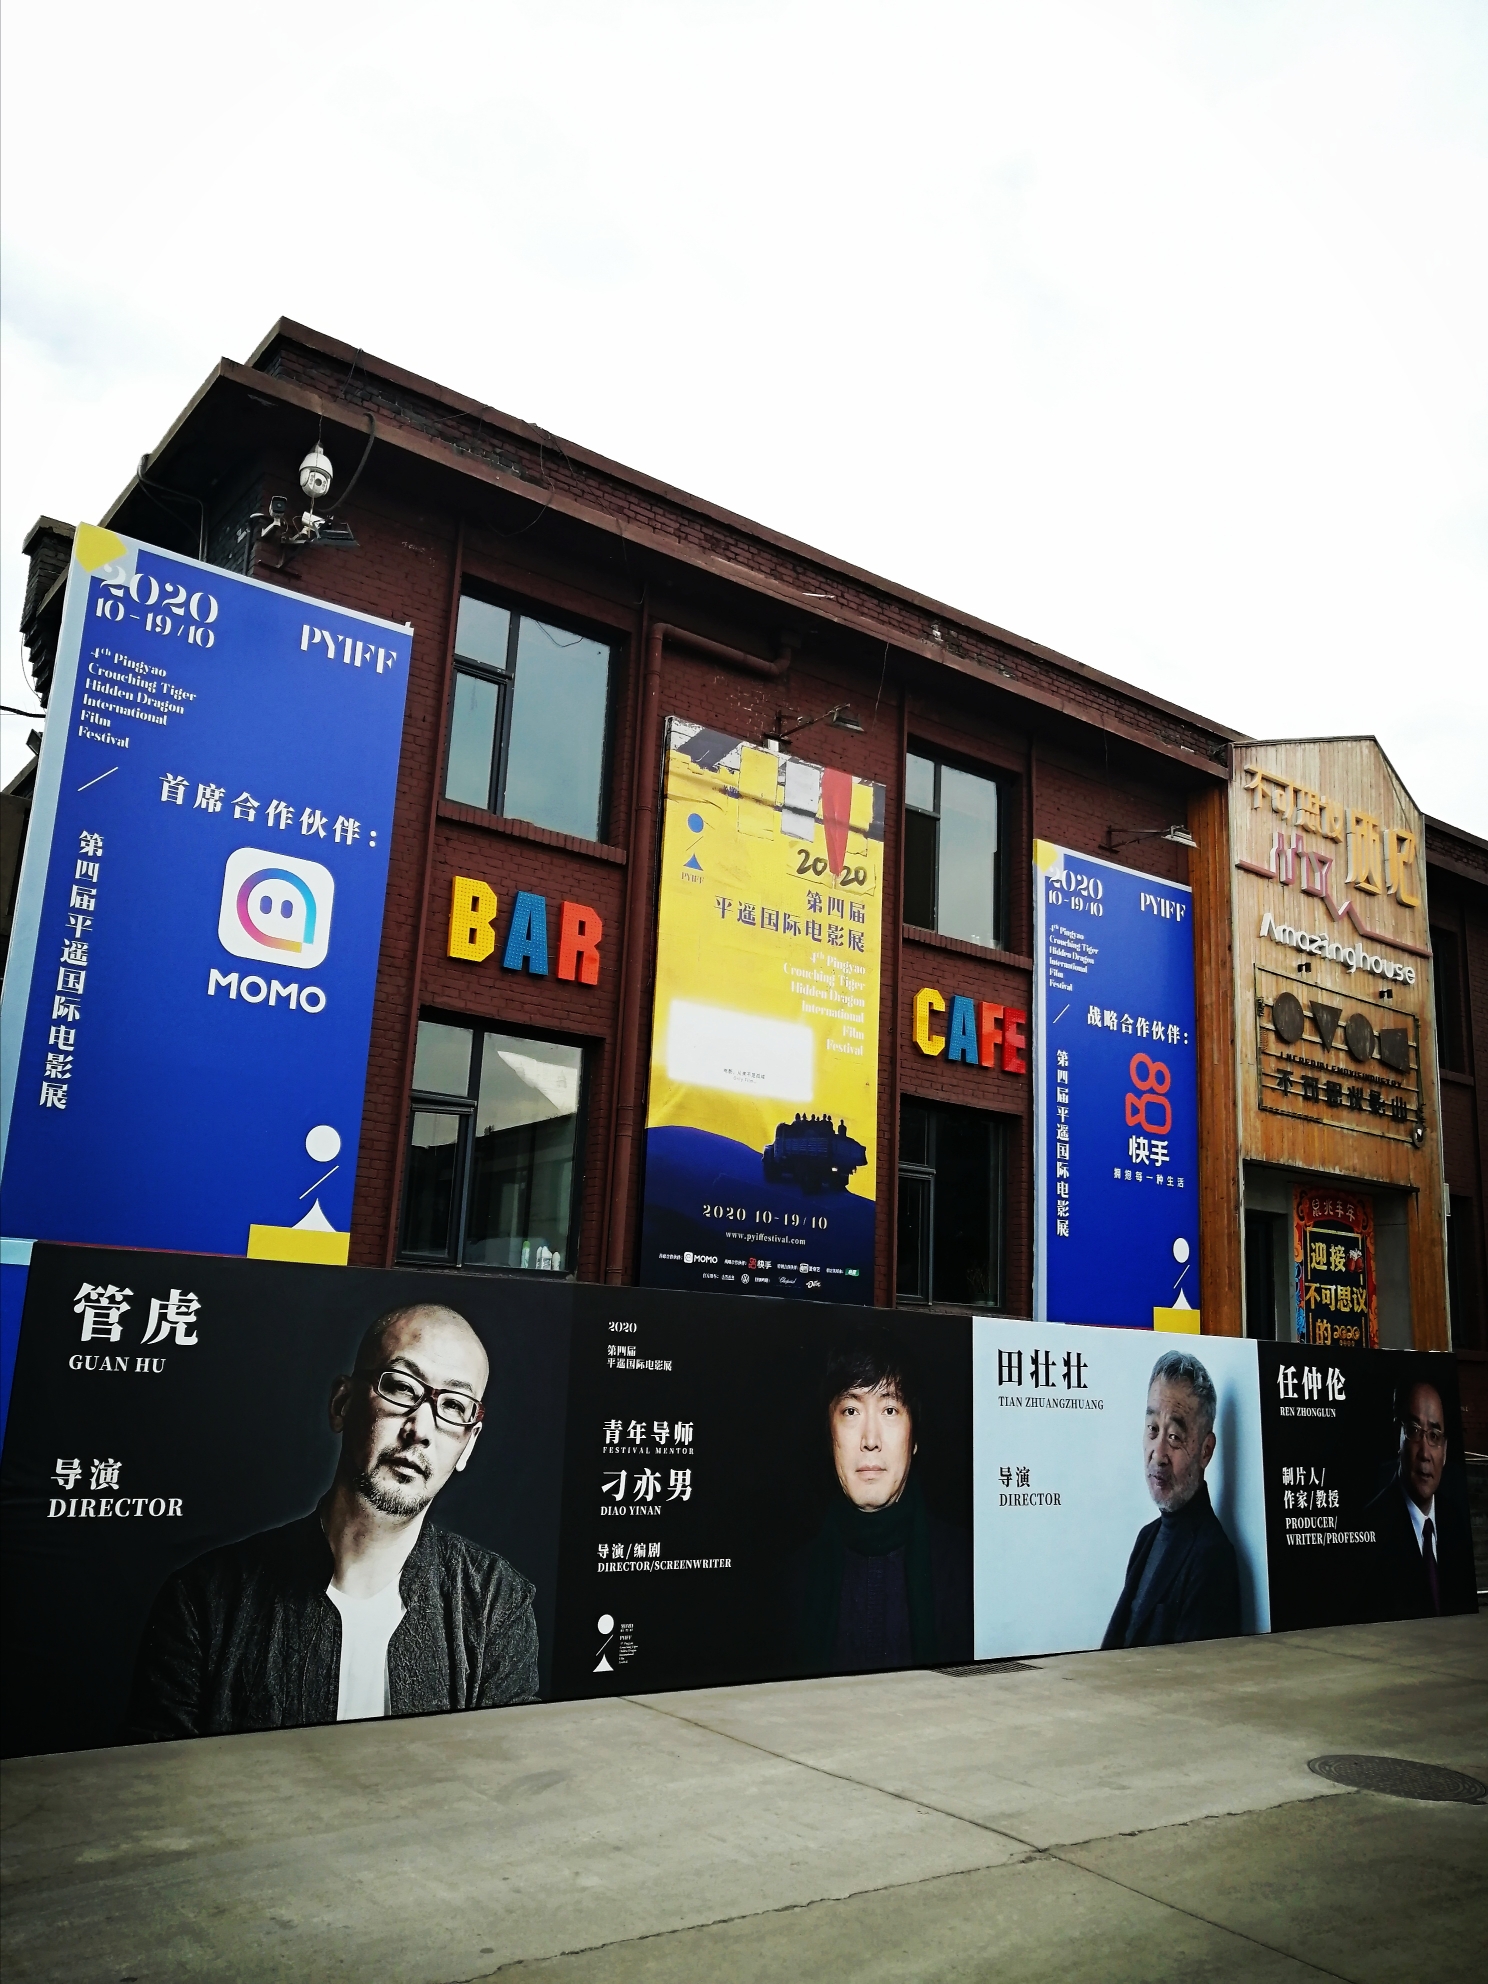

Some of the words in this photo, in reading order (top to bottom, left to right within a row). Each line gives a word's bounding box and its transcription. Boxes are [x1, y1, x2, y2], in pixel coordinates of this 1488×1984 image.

[100, 564, 218, 624] 2020
[300, 624, 397, 674] PYIFF
[113, 652, 167, 677] Pingyao
[88, 662, 157, 693] Crouching
[161, 682, 197, 702] Tiger
[85, 678, 134, 702] Hidden
[137, 693, 185, 715] Dragon
[80, 709, 112, 728] Film
[82, 694, 168, 727] International
[78, 725, 130, 749] Festival
[681, 871, 705, 885] PYIFF
[1048, 866, 1103, 900] 2020
[806, 889, 865, 924] 第四届
[1140, 892, 1186, 922] PYIFF
[447, 875, 603, 986] BAR
[714, 895, 865, 953] 平遥国际电影展
[1059, 927, 1085, 941] Pingyao
[1049, 935, 1081, 952] Crouching
[1081, 943, 1100, 955] Tiger
[1049, 946, 1072, 959] Hidden
[1073, 951, 1095, 965] Dragon
[39, 829, 104, 1110] 第四届平遥国际电影展
[827, 955, 866, 975] Pingyao
[1049, 957, 1088, 974] International
[1049, 968, 1064, 979] Film
[783, 964, 836, 985] Crouching
[839, 976, 866, 992] Tiger
[1049, 979, 1073, 992] Festival
[207, 968, 326, 1014] MOMO
[790, 981, 827, 1000] Hidden
[829, 989, 865, 1008] Dragon
[801, 1001, 865, 1024] International
[842, 1026, 865, 1041] Film
[912, 987, 1027, 1074] CAFE
[826, 1039, 864, 1057] Festival
[1056, 1049, 1070, 1238] 第四届平遥国际电影展
[1128, 1135, 1170, 1167] 快手
[1113, 1167, 1185, 1188] 拥抱每一种生活
[702, 1204, 747, 1221] 2020
[725, 1231, 806, 1246] www.pyiffestival.com
[694, 1254, 718, 1264] MOMO
[1310, 1242, 1346, 1273] 迎接
[1305, 1282, 1368, 1314] 不可思议
[73, 1282, 201, 1345] 管虎
[608, 1321, 638, 1333] 2020
[606, 1344, 636, 1357] 第四届
[68, 1354, 130, 1372] GUAN
[134, 1357, 167, 1374] HU
[606, 1357, 673, 1371] 平遥国际电影展
[998, 1348, 1089, 1390] 田壮壮
[1276, 1364, 1347, 1401] 任仲伦
[998, 1396, 1023, 1408] TIAN
[1025, 1396, 1104, 1410] ZHUANGZHUANG
[1280, 1406, 1295, 1417] REN
[1296, 1407, 1336, 1418] ZHONGLUN
[602, 1419, 694, 1446] 青年导师
[602, 1446, 650, 1455] FESTIVAL
[655, 1447, 694, 1455] MENTOR
[50, 1458, 123, 1491] 导演
[601, 1467, 693, 1503] 刁亦男
[998, 1466, 1031, 1488] 导演
[1281, 1466, 1326, 1487] 制片人/
[47, 1497, 184, 1518] DIRECTOR
[999, 1492, 1062, 1506] DIRECTOR
[1283, 1489, 1340, 1511] 作家/教授
[600, 1505, 627, 1516] DIAO
[629, 1505, 662, 1516] YINAN
[1285, 1515, 1338, 1530] PRODUCER/
[1286, 1531, 1377, 1547] WRITER/PROFESSOR
[597, 1542, 661, 1560] 导演/编剧
[597, 1558, 732, 1573] DIRECTOR/SCREENWRITER
